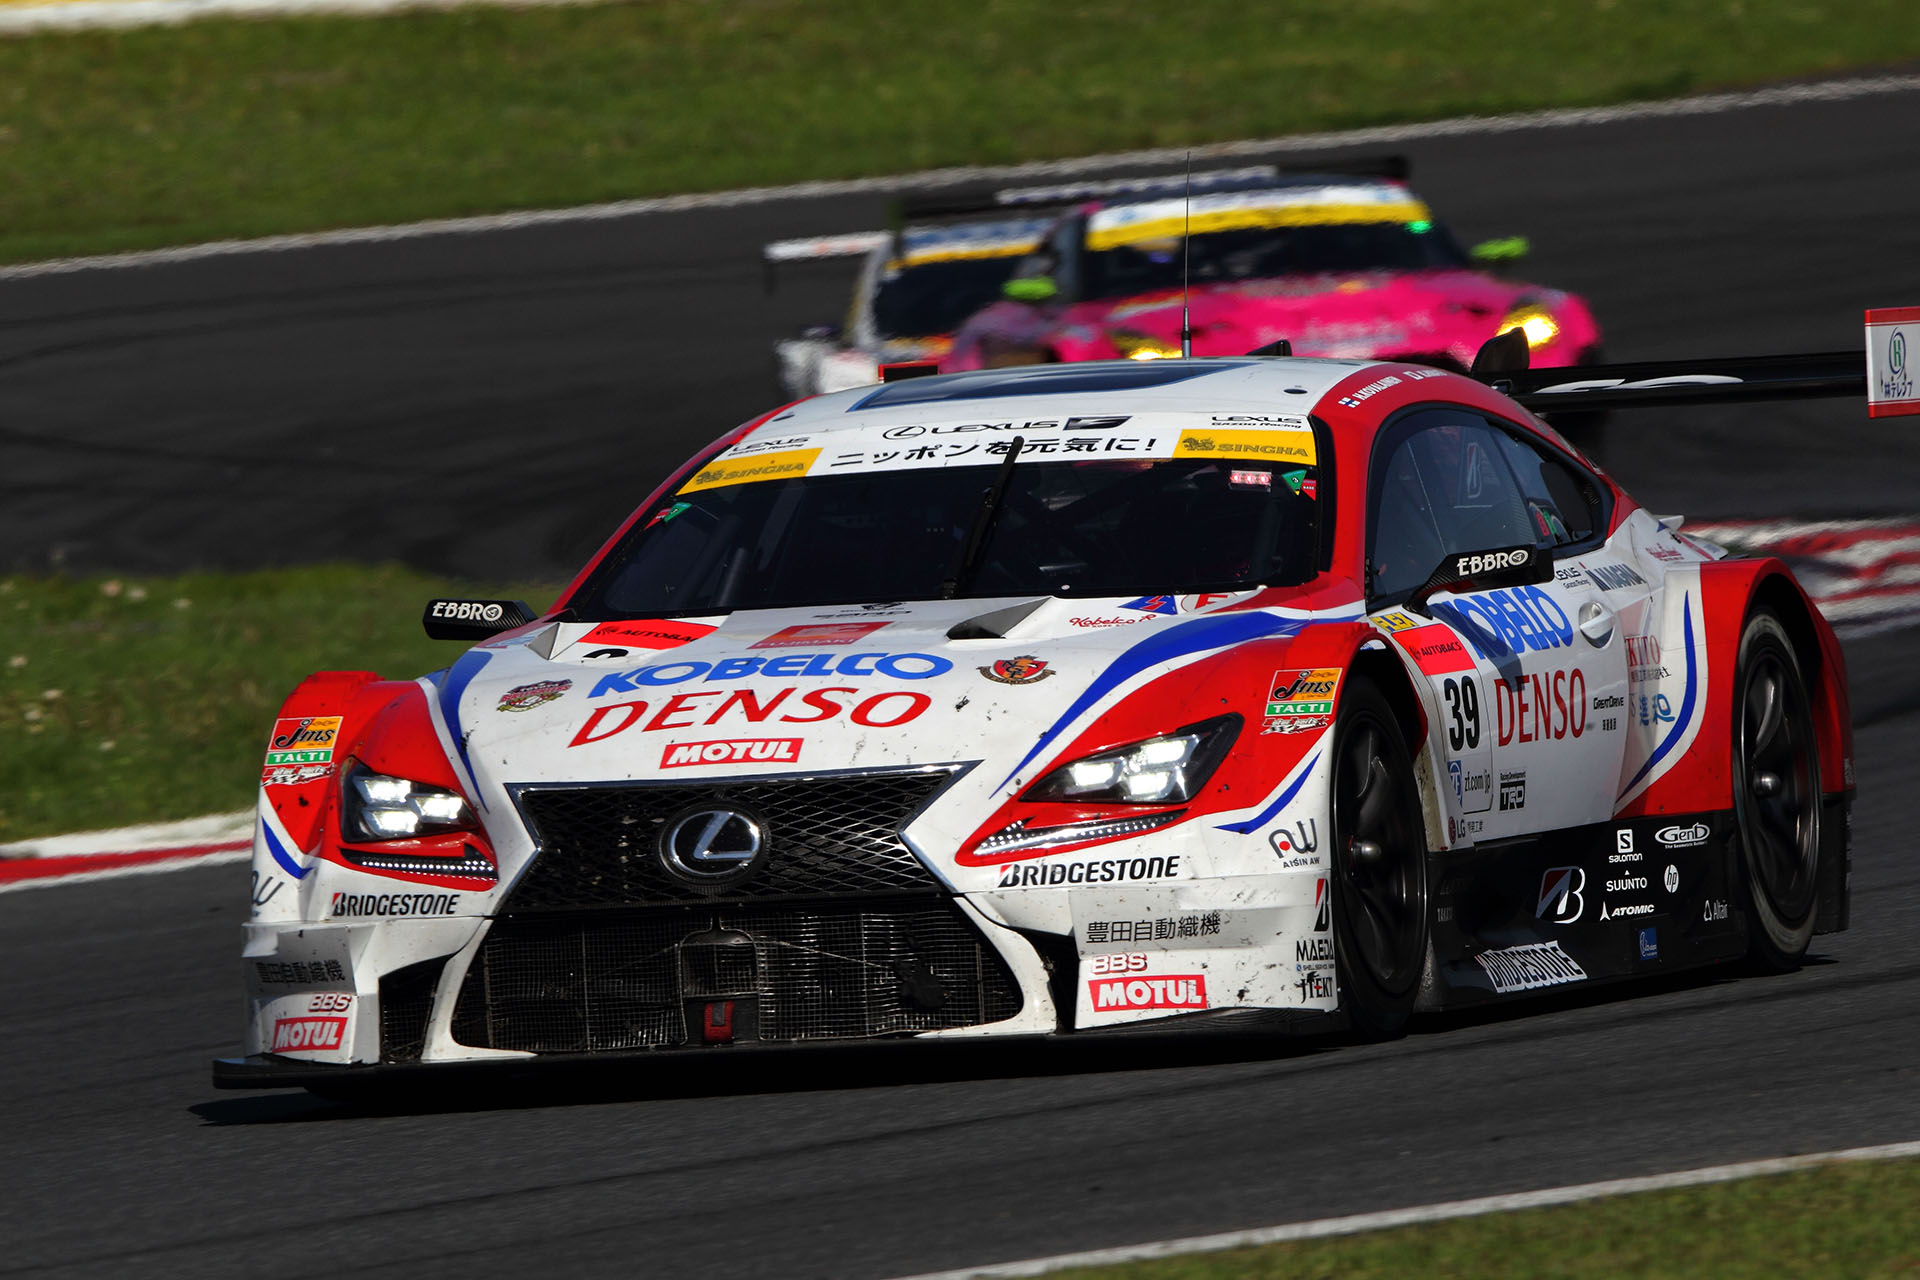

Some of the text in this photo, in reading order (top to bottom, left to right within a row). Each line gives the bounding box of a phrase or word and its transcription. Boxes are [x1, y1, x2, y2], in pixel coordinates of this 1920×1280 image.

[931, 420, 1059, 434] LEXUS
[1211, 416, 1302, 424] LEXUS
[733, 436, 810, 452] LEXUS
[1217, 443, 1309, 457] SINGHA
[723, 462, 806, 480] SINGHA
[1457, 550, 1529, 577] EBBRO
[432, 602, 503, 622] EBBRO
[1421, 641, 1462, 658] AUTOBACS
[587, 652, 954, 699] KOBELCO
[568, 687, 932, 748] DENSO
[1273, 704, 1325, 714] TACTI
[1443, 675, 1481, 752] 39
[1494, 668, 1587, 747] DENSO
[273, 752, 325, 763] TACTI
[665, 740, 800, 766] MOTUL
[998, 855, 1180, 888] BRIDGESTONE
[1283, 857, 1320, 869] AISIN AW
[1606, 877, 1648, 892] SUUNTO
[333, 892, 460, 917] BRIDGESTONE
[1611, 904, 1655, 917] ATOMIC
[1086, 911, 1221, 944] 豊田自動織機
[1296, 939, 1335, 961] MAEDA
[1089, 951, 1149, 975] BBS
[1474, 940, 1588, 993] BRIDGESTONE
[308, 992, 353, 1013] BBS
[1097, 979, 1202, 1007] MOTUL
[275, 1021, 340, 1049] MOTUL
